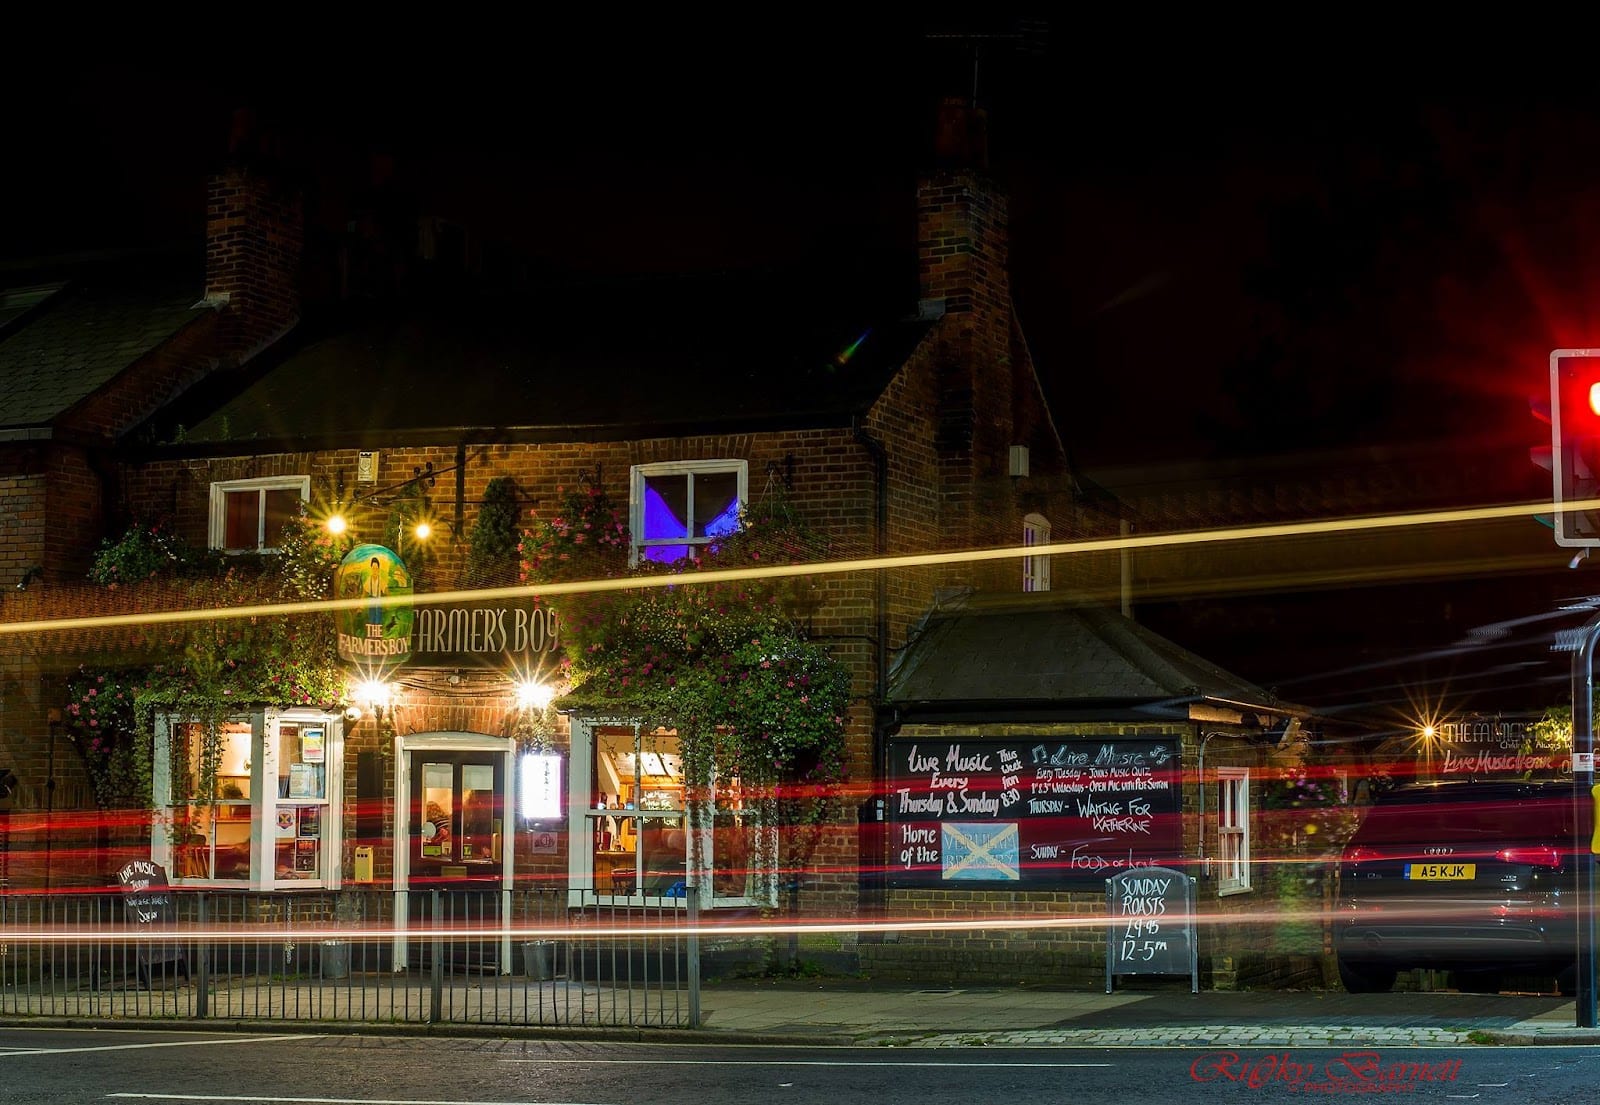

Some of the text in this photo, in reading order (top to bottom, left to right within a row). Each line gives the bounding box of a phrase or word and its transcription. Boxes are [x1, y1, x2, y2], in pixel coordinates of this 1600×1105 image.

[365, 624, 383, 638] THE
[513, 607, 559, 653] BOY
[339, 633, 408, 656] FARMERS BOY
[1443, 723, 1472, 742] THE
[908, 744, 992, 773] Live Music
[1050, 744, 1089, 766] Live
[1443, 749, 1474, 773] Live
[1474, 749, 1515, 775] Music
[930, 772, 968, 789] Every
[1132, 766, 1152, 777] QUIZ
[897, 787, 999, 817] Thursday & Sunday
[1077, 794, 1123, 818] WAITING
[1128, 796, 1153, 819] FOR
[901, 824, 936, 845] Home
[1092, 816, 1151, 835] KATHERINE
[901, 846, 939, 870] of the
[1071, 843, 1110, 874] FOOD
[120, 861, 156, 884] LIVE MUSIC
[1421, 866, 1437, 877] A5
[1440, 866, 1465, 877] KJK
[1120, 877, 1171, 897] SUNDAY
[1122, 896, 1165, 916] ROASTS
